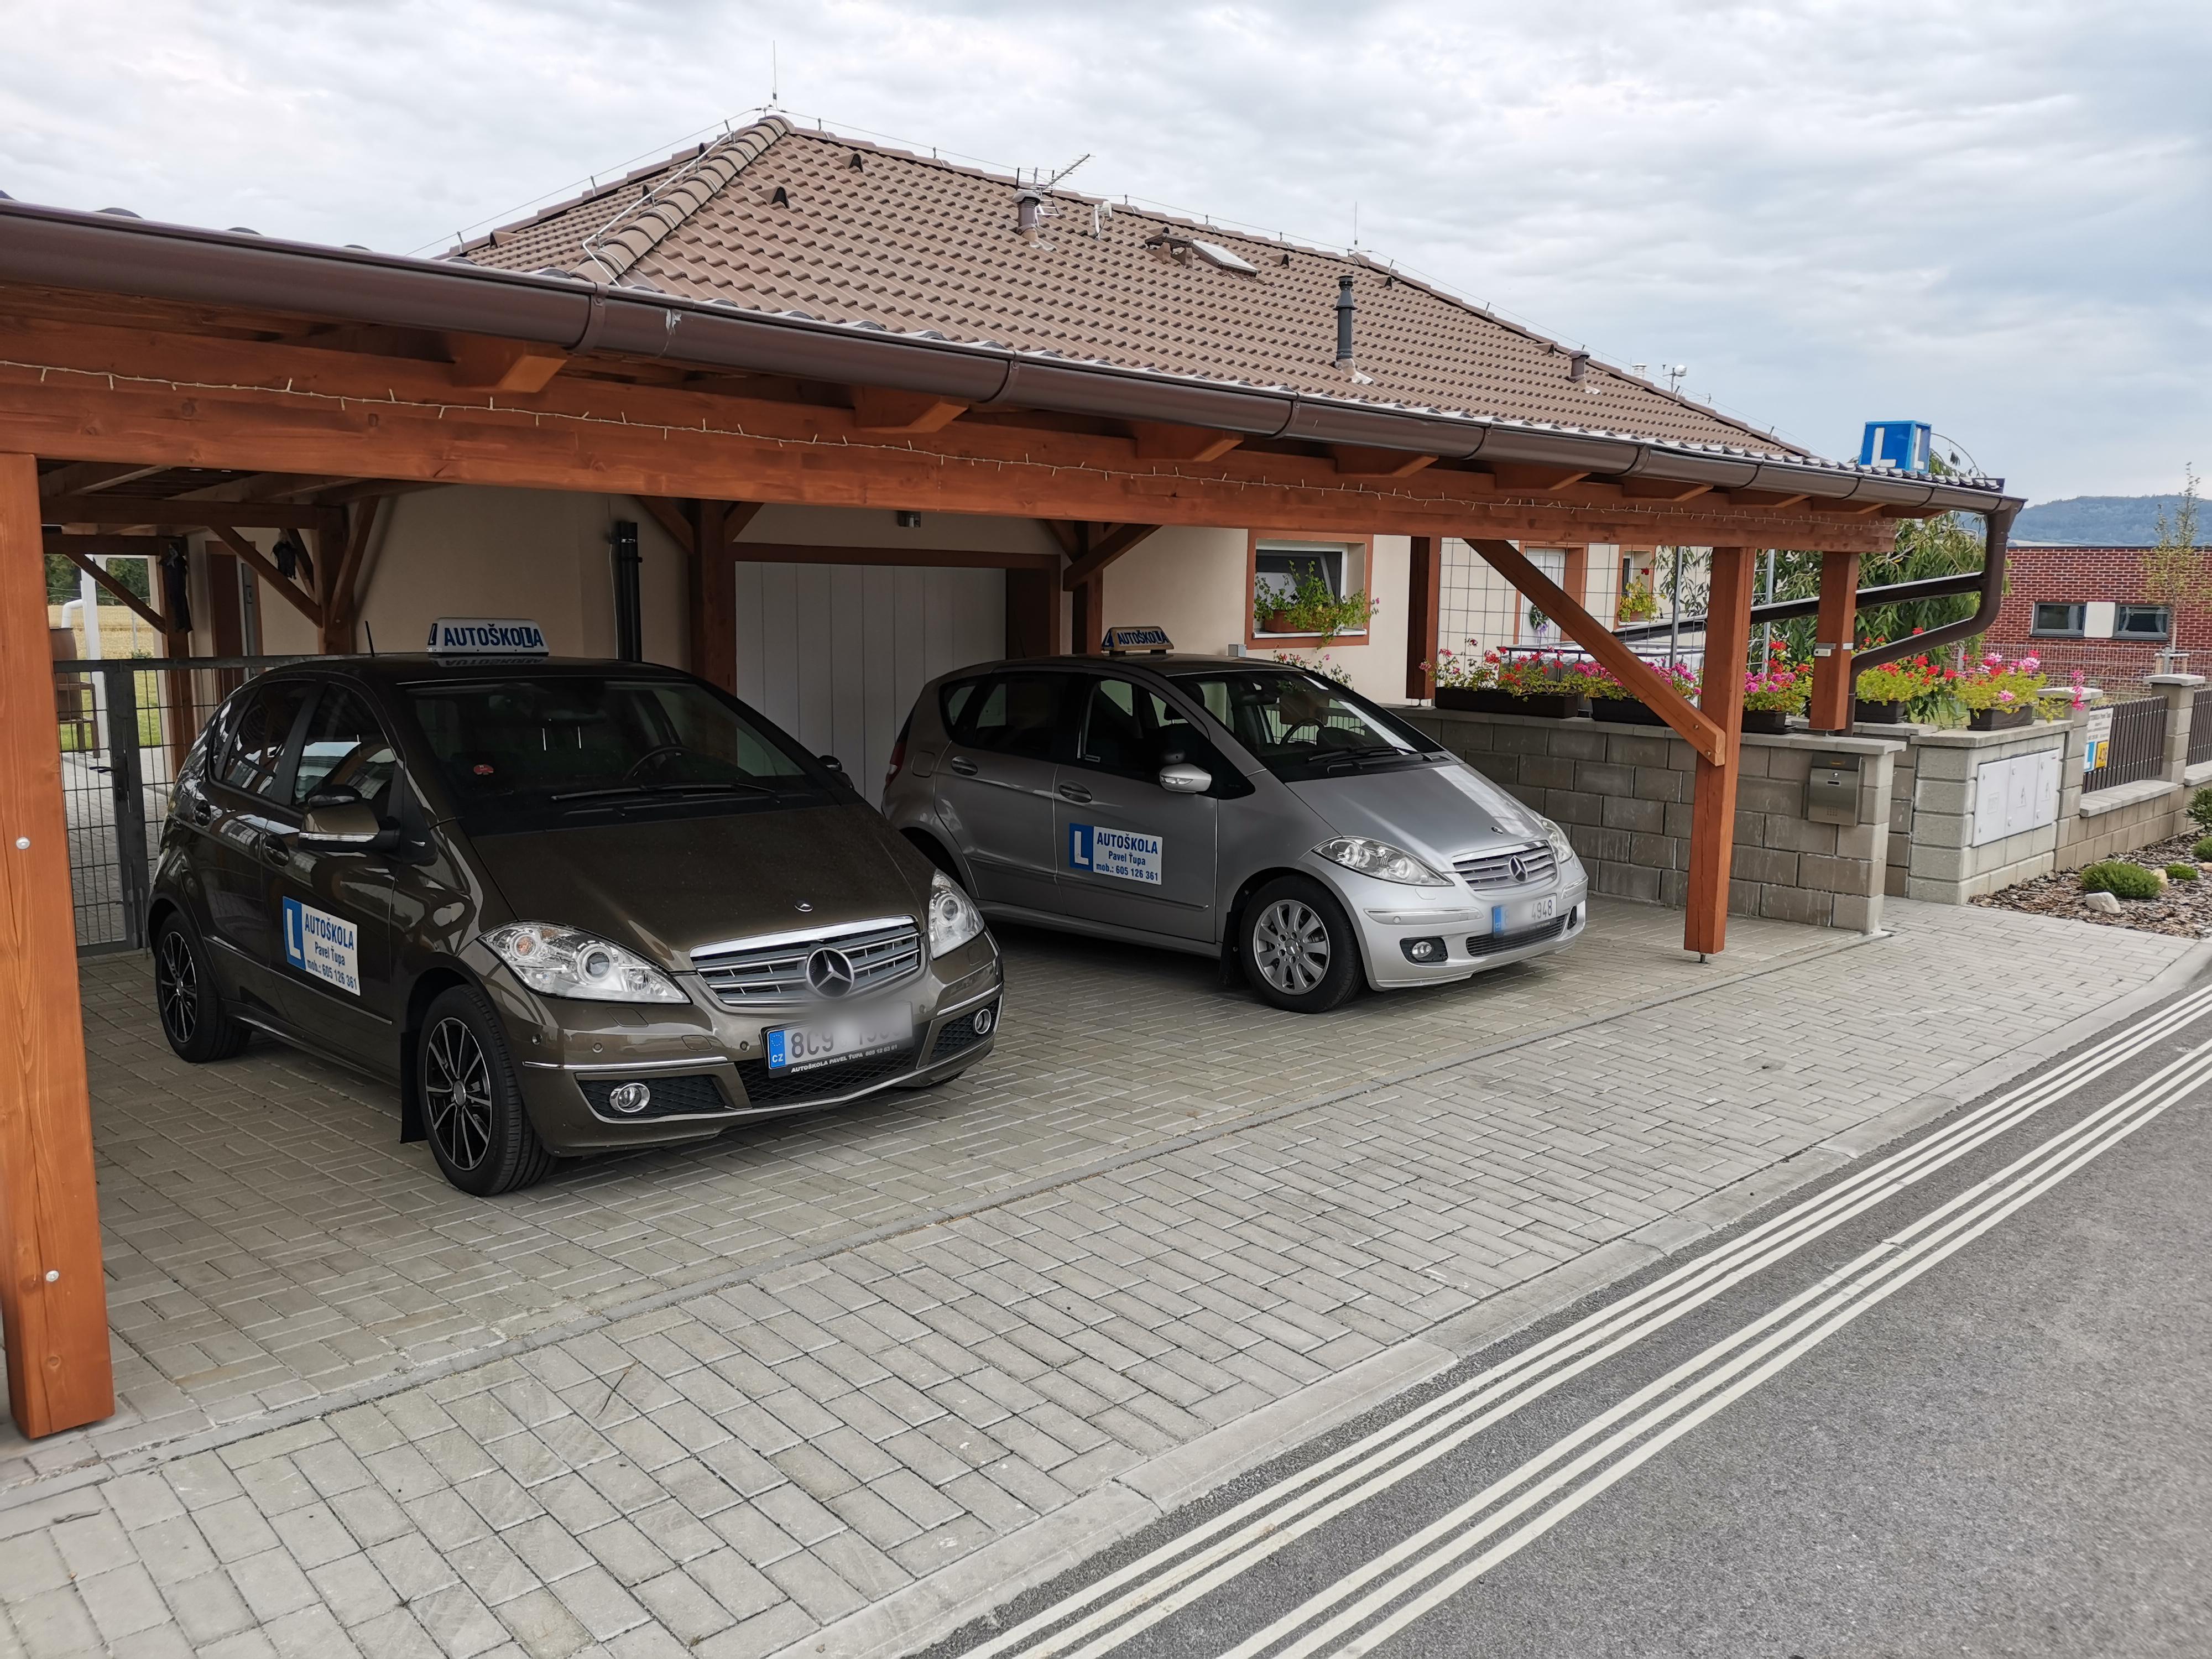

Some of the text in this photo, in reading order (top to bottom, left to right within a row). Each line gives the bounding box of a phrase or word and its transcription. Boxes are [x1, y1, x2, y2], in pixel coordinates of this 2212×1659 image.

[444, 623, 544, 648] AUTOŠKOLA
[1117, 630, 1169, 644] AUTOŠKOLA
[1074, 831, 1089, 865] L
[1097, 832, 1159, 855] AUTOŠKOLA
[1108, 851, 1146, 867] Pavel Ťupa
[1096, 863, 1159, 881] mob.: 605 126 361
[286, 908, 301, 959] L
[305, 913, 354, 951] AUTOŠKOLA
[315, 941, 346, 967] Pavel Ťupa
[307, 959, 357, 990] mob.: 605 126 361
[772, 1053, 784, 1063] CZ
[791, 1061, 828, 1073] AUTOŠKOLA
[830, 1056, 847, 1065] PAVEL
